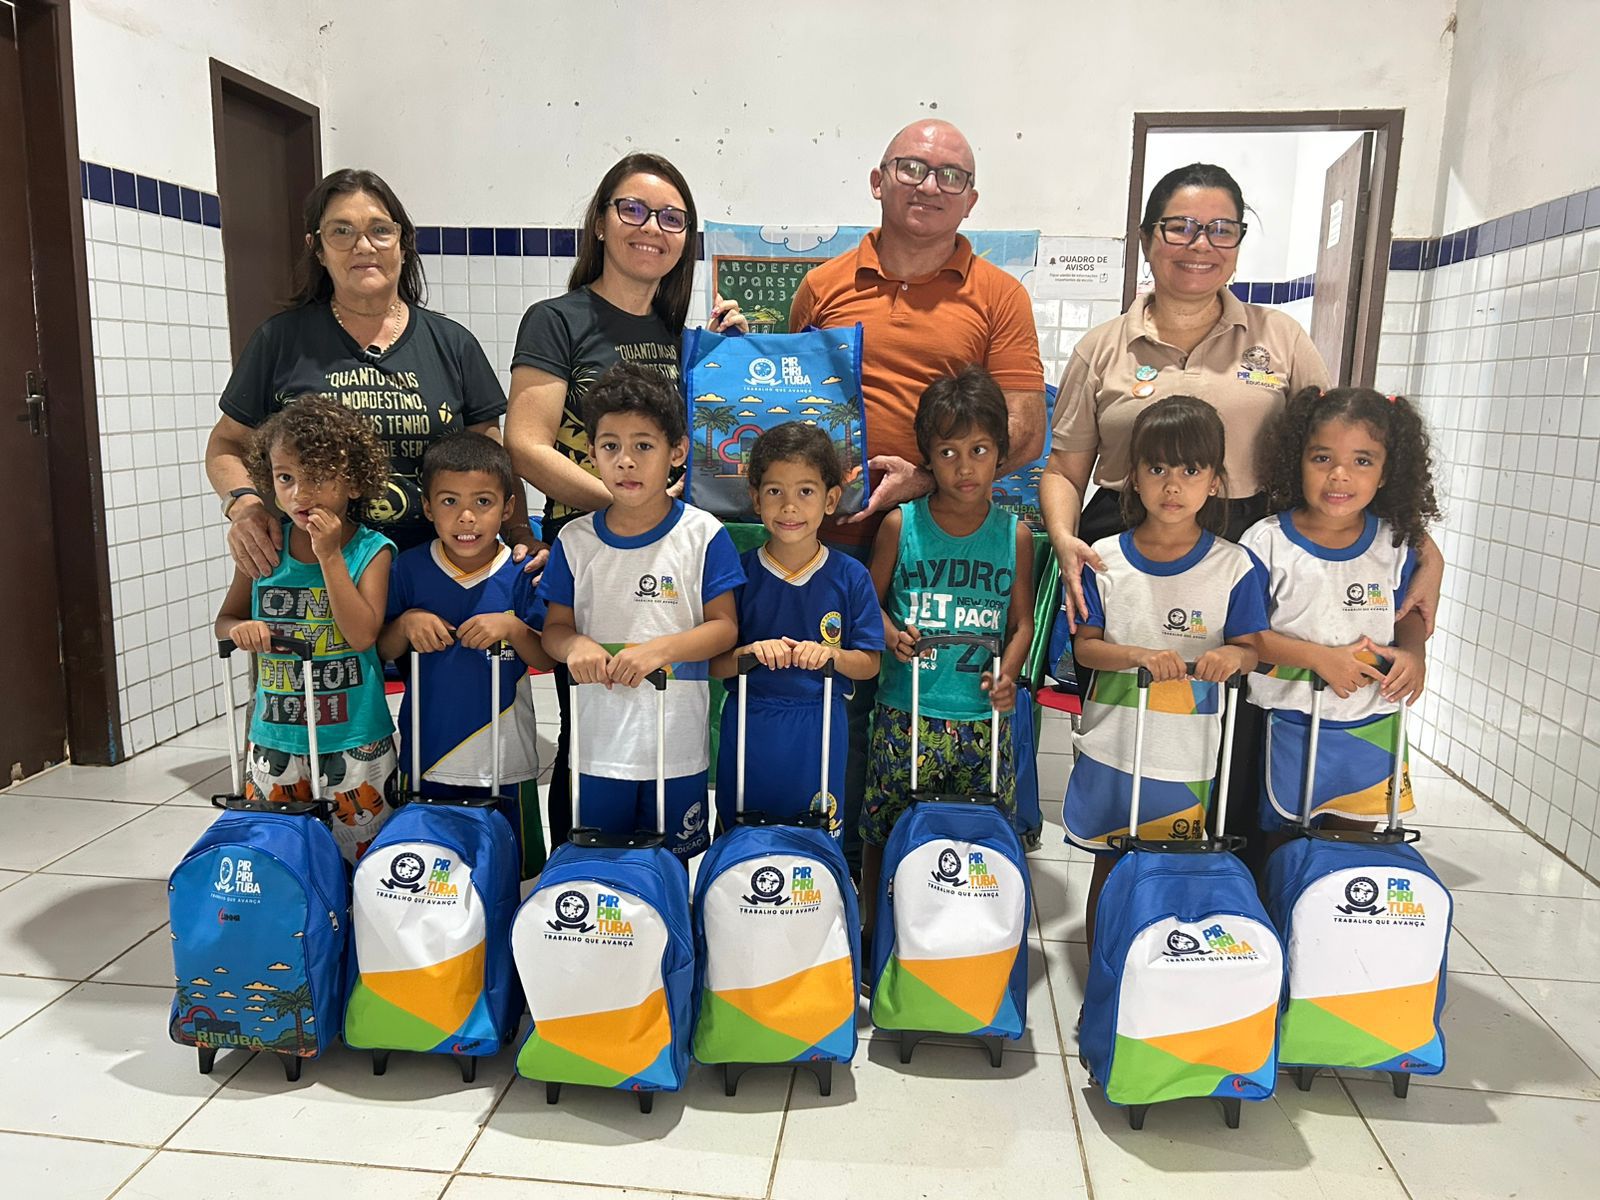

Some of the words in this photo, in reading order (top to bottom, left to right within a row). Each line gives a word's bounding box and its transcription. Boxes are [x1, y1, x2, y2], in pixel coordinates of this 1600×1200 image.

[781, 356, 798, 367] PIR
[782, 366, 801, 377] PIRI
[385, 371, 419, 390] MAIS
[783, 375, 811, 385] TUBA
[342, 391, 427, 412] NORDESTINO,
[387, 415, 430, 434] TENHO
[900, 559, 1012, 597] HYDRO
[905, 592, 952, 625] JET
[957, 597, 981, 606] NEW
[985, 600, 1006, 609] YORK
[955, 607, 1000, 629] PACK
[270, 696, 339, 723] 1981
[969, 852, 984, 864] PIR
[237, 859, 252, 871] PIR
[433, 858, 451, 871] PIR
[969, 864, 987, 875] PIRI
[236, 871, 253, 882] PIRI
[430, 870, 450, 882] PIRI
[793, 866, 812, 879] PIR
[792, 878, 814, 890] PIRI
[969, 874, 998, 886] TUBA
[1387, 878, 1411, 891] PIR
[235, 881, 261, 893] TUBA
[427, 881, 458, 894] TUBA
[928, 882, 955, 895] TRABALHO
[376, 891, 412, 902] TRABALHO
[597, 894, 619, 908] PIR
[792, 889, 821, 902] TUBA
[1387, 890, 1414, 902] PIRI
[597, 908, 622, 920] PIRI
[740, 907, 777, 915] TRABALHO
[795, 906, 819, 914] AVANÇA
[1387, 902, 1425, 914] TUBA
[597, 920, 632, 933] TUBA
[1202, 924, 1226, 940] PIR
[544, 934, 582, 943] TRABALHO
[1208, 933, 1236, 949] PIRI
[196, 1030, 263, 1047] RITUBA
